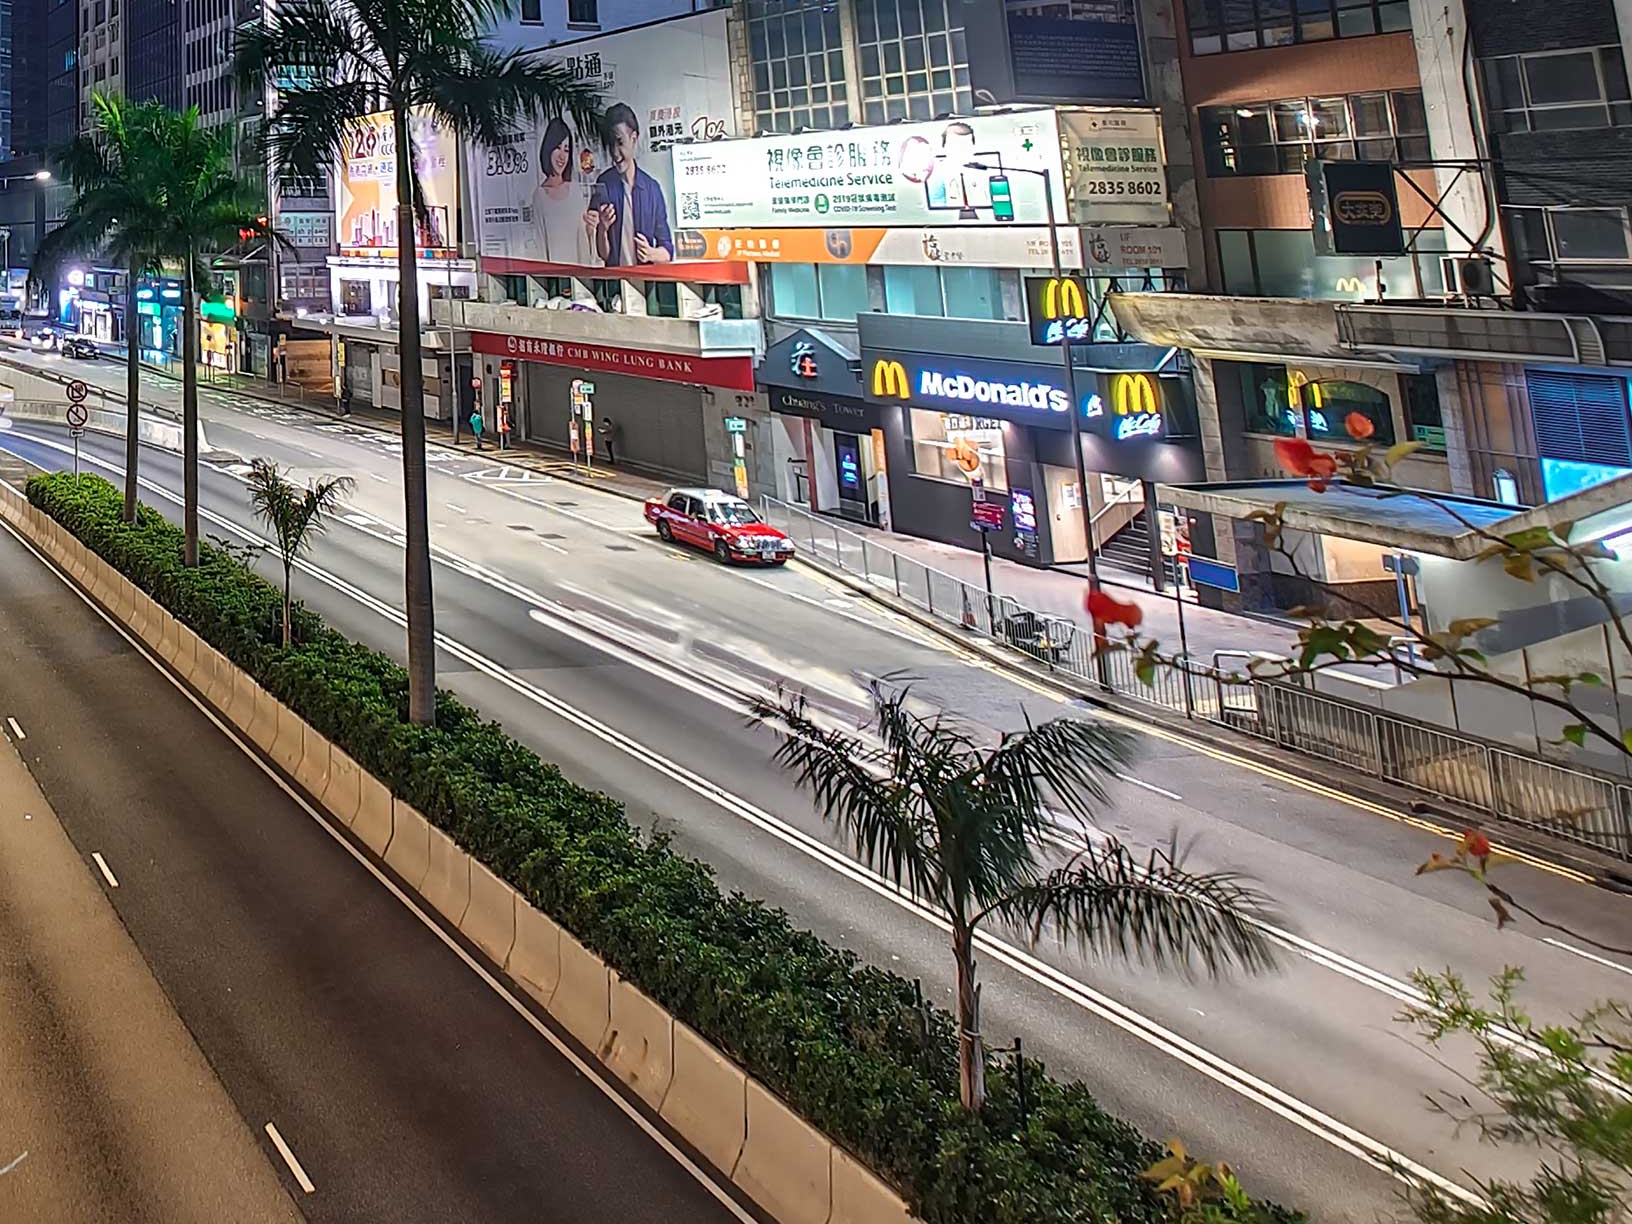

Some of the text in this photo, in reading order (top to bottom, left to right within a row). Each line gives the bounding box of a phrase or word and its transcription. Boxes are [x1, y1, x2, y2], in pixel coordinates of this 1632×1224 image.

[847, 173, 893, 186] Service
[1088, 181, 1162, 195] 2835 8602
[567, 347, 589, 359] CMB
[591, 350, 620, 363] WING
[623, 354, 654, 368] LUNG
[658, 359, 693, 373] BANK
[920, 370, 1070, 412] McDonald's
